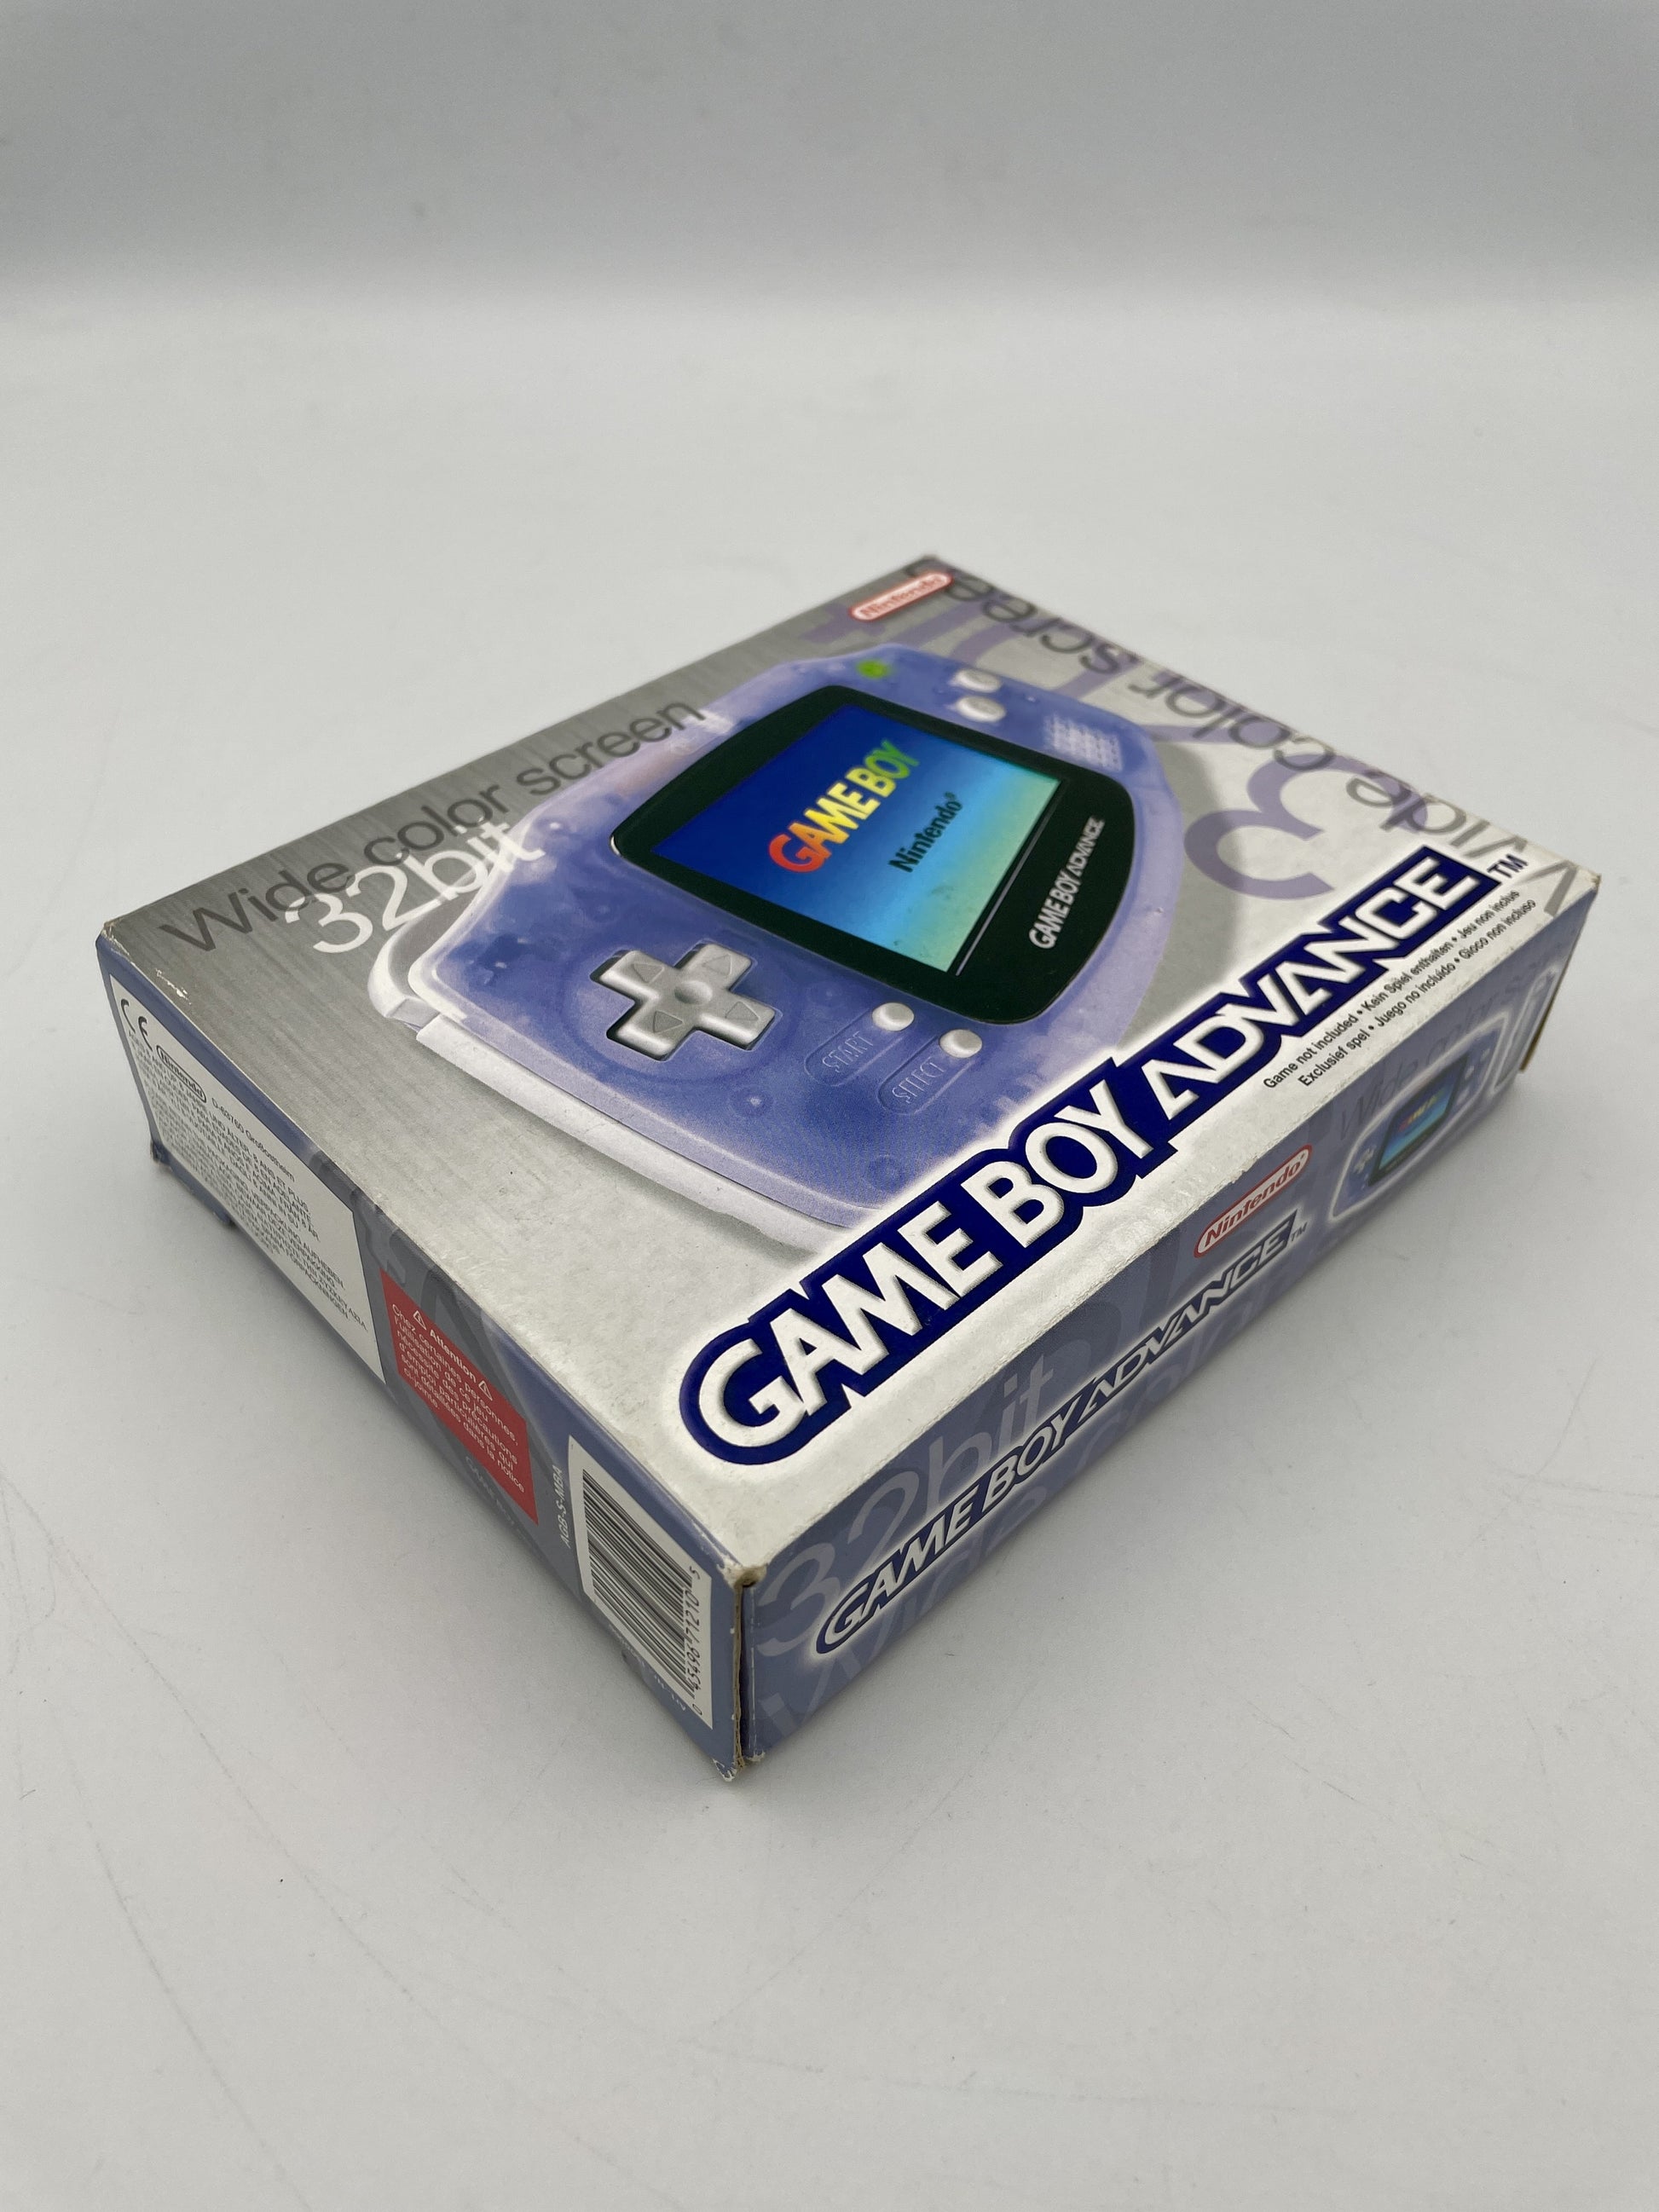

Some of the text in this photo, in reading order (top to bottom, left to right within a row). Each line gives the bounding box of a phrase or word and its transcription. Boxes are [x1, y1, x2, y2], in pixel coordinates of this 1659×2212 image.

[159, 699, 707, 953] Wide color screen
[768, 737, 921, 874] GAME BOY
[285, 814, 546, 954] 32bit
[1028, 815, 1106, 950] GAME BOY ADVANCE
[1263, 889, 1521, 1089] Game not included Kein Spiel enthalten Jeu non inclus
[1298, 1045, 1350, 1086] Exclusief
[1346, 1029, 1372, 1048] spel
[1374, 1000, 1407, 1027] Juego
[1404, 990, 1421, 1004] no
[1458, 937, 1489, 960] Gioco
[1486, 922, 1508, 941] non
[1500, 898, 1537, 927] incluso
[822, 1030, 875, 1074] START
[211, 1096, 246, 1134] D-63760
[697, 1202, 1004, 1449] GAME
[961, 1079, 1155, 1250] BOY
[1148, 856, 1482, 1118] ADVANCE
[1199, 1152, 1306, 1250] Nintendo
[391, 1301, 518, 1448] Chez certaines personnes,
[428, 1325, 477, 1385] Attention
[443, 1368, 457, 1390] de
[458, 1385, 471, 1405] ce
[471, 1399, 489, 1429] jeu
[441, 1376, 460, 1403] des
[461, 1397, 518, 1468] précautions
[462, 1418, 485, 1451] dans
[486, 1444, 495, 1463] la
[496, 1456, 525, 1496] notice
[498, 1448, 514, 1475] qui
[823, 1484, 985, 1647] GAME
[983, 1401, 1090, 1500] BOY
[1078, 1224, 1293, 1418] ADVANCE
[552, 1464, 571, 1550] AGB-S-MBA
